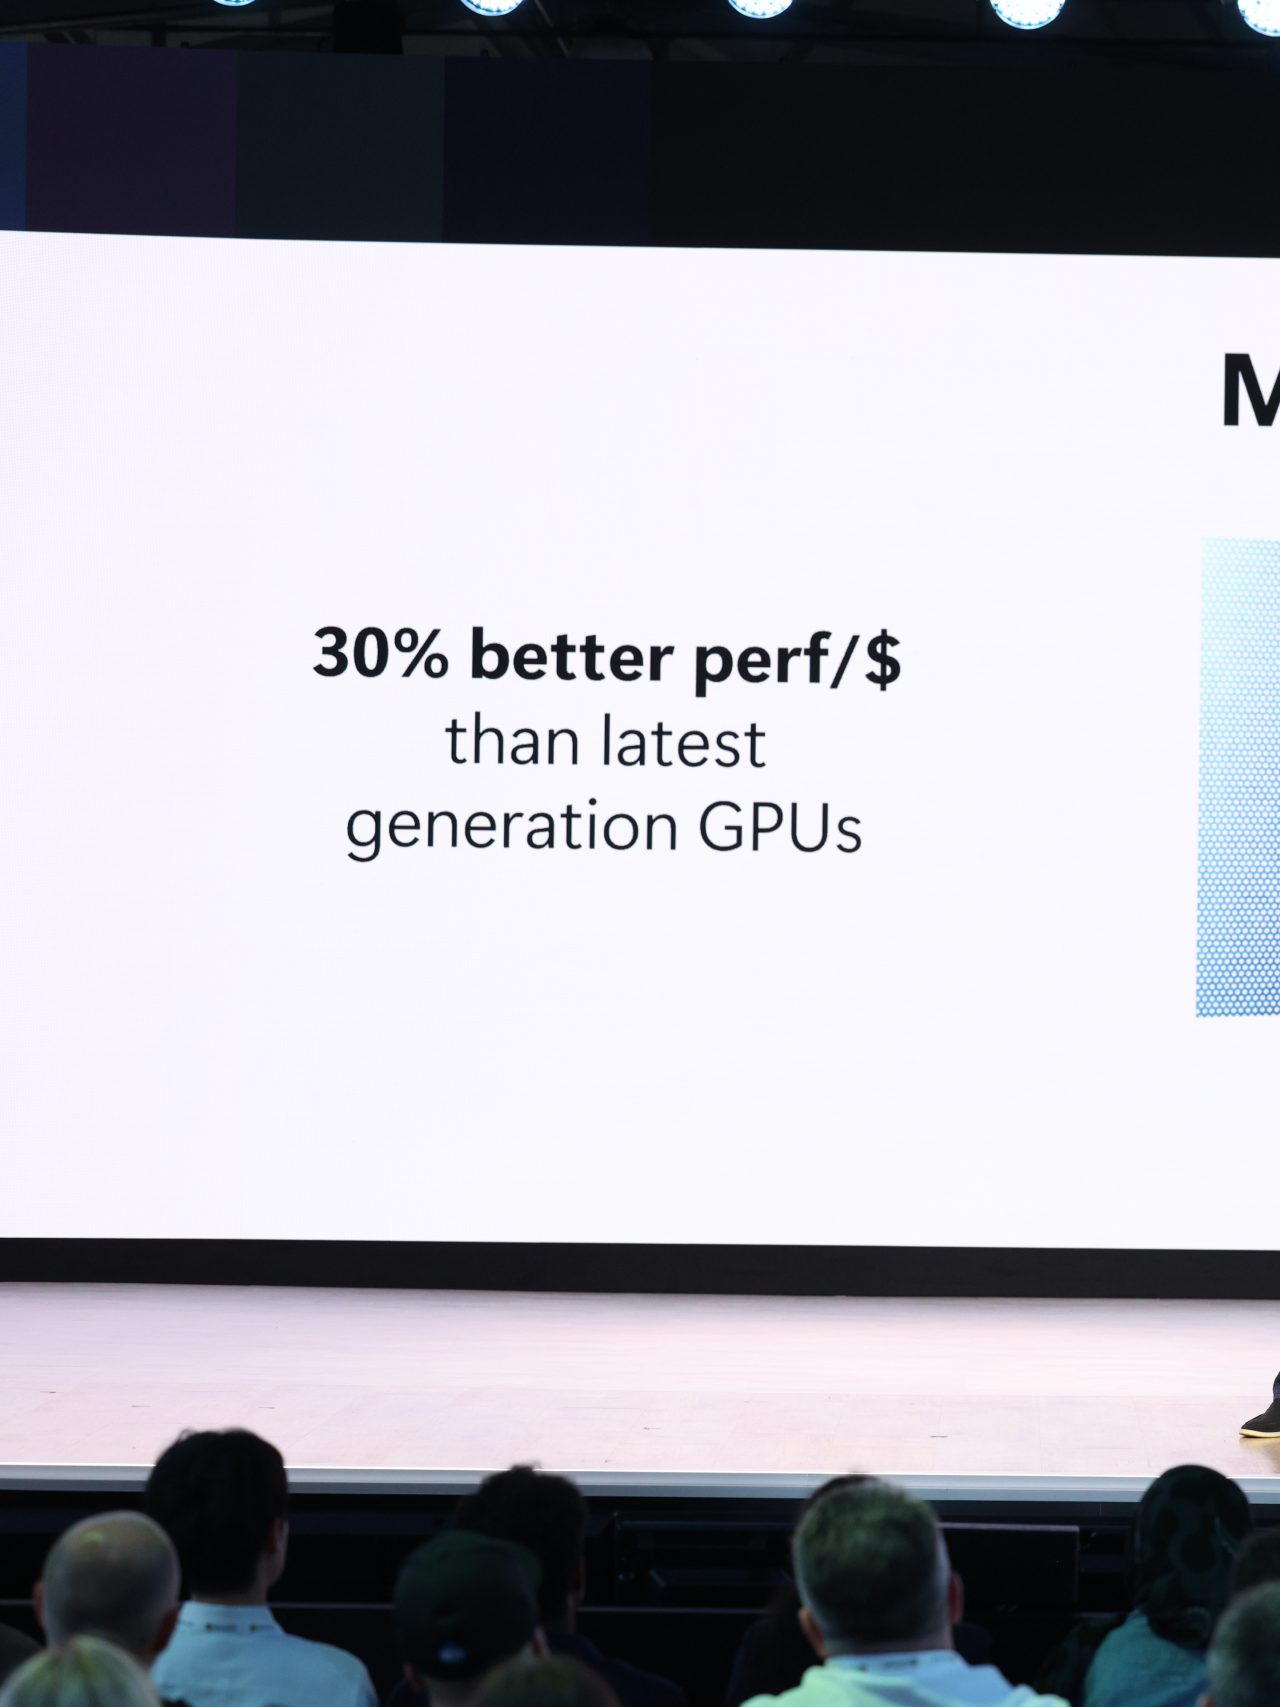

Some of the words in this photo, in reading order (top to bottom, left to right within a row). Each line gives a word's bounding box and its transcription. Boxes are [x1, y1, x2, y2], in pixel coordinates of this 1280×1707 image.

[312, 625, 449, 679] 30%
[471, 625, 676, 682] better
[695, 628, 901, 698] perf/$
[444, 710, 578, 766] than
[603, 712, 766, 769] latest
[346, 797, 677, 863] generation
[699, 800, 862, 854] GPUs
